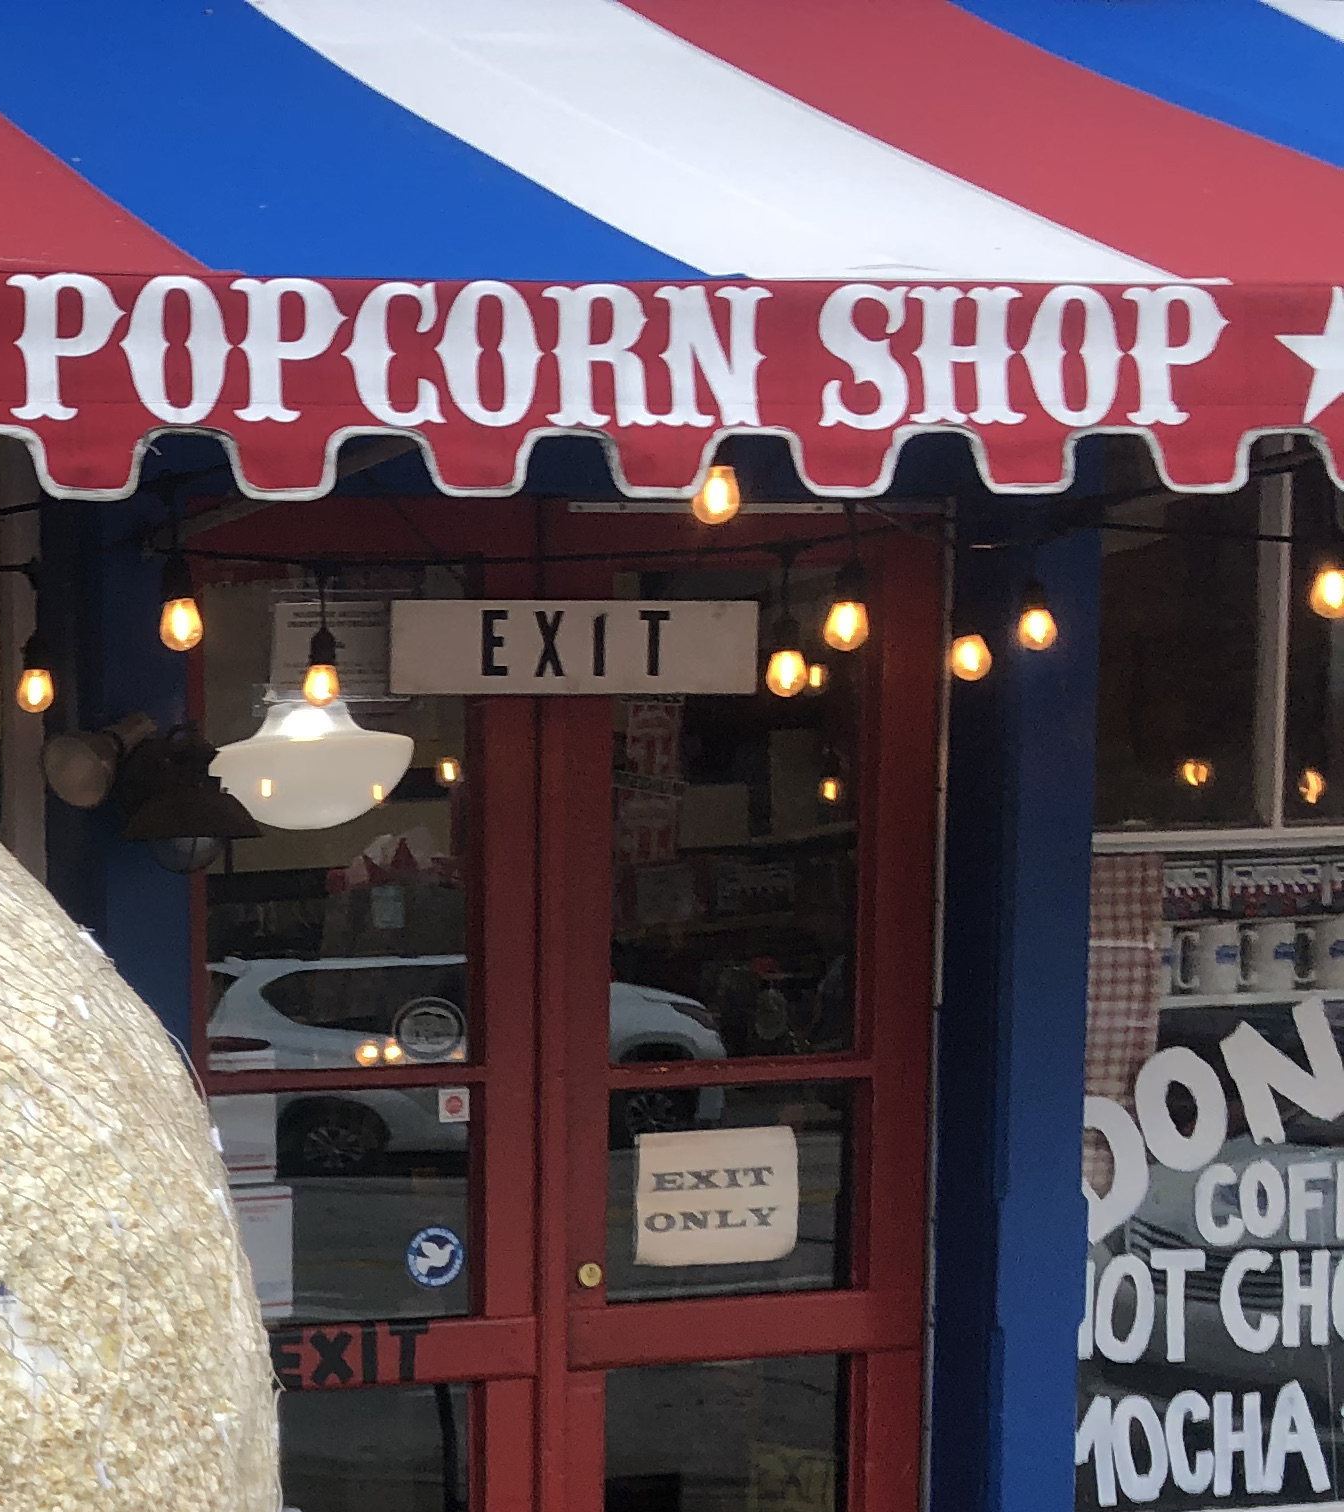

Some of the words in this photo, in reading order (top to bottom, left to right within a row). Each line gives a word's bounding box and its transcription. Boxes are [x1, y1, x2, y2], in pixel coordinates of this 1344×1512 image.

[5, 271, 772, 427] POPCORN
[818, 284, 1230, 430] SHOP
[481, 609, 671, 678] EXIT
[650, 1166, 775, 1193] EXIT
[1194, 1159, 1344, 1246] COF
[643, 1206, 778, 1234] ONLY
[1219, 1249, 1344, 1354] CH
[269, 1319, 430, 1388] EXIT
